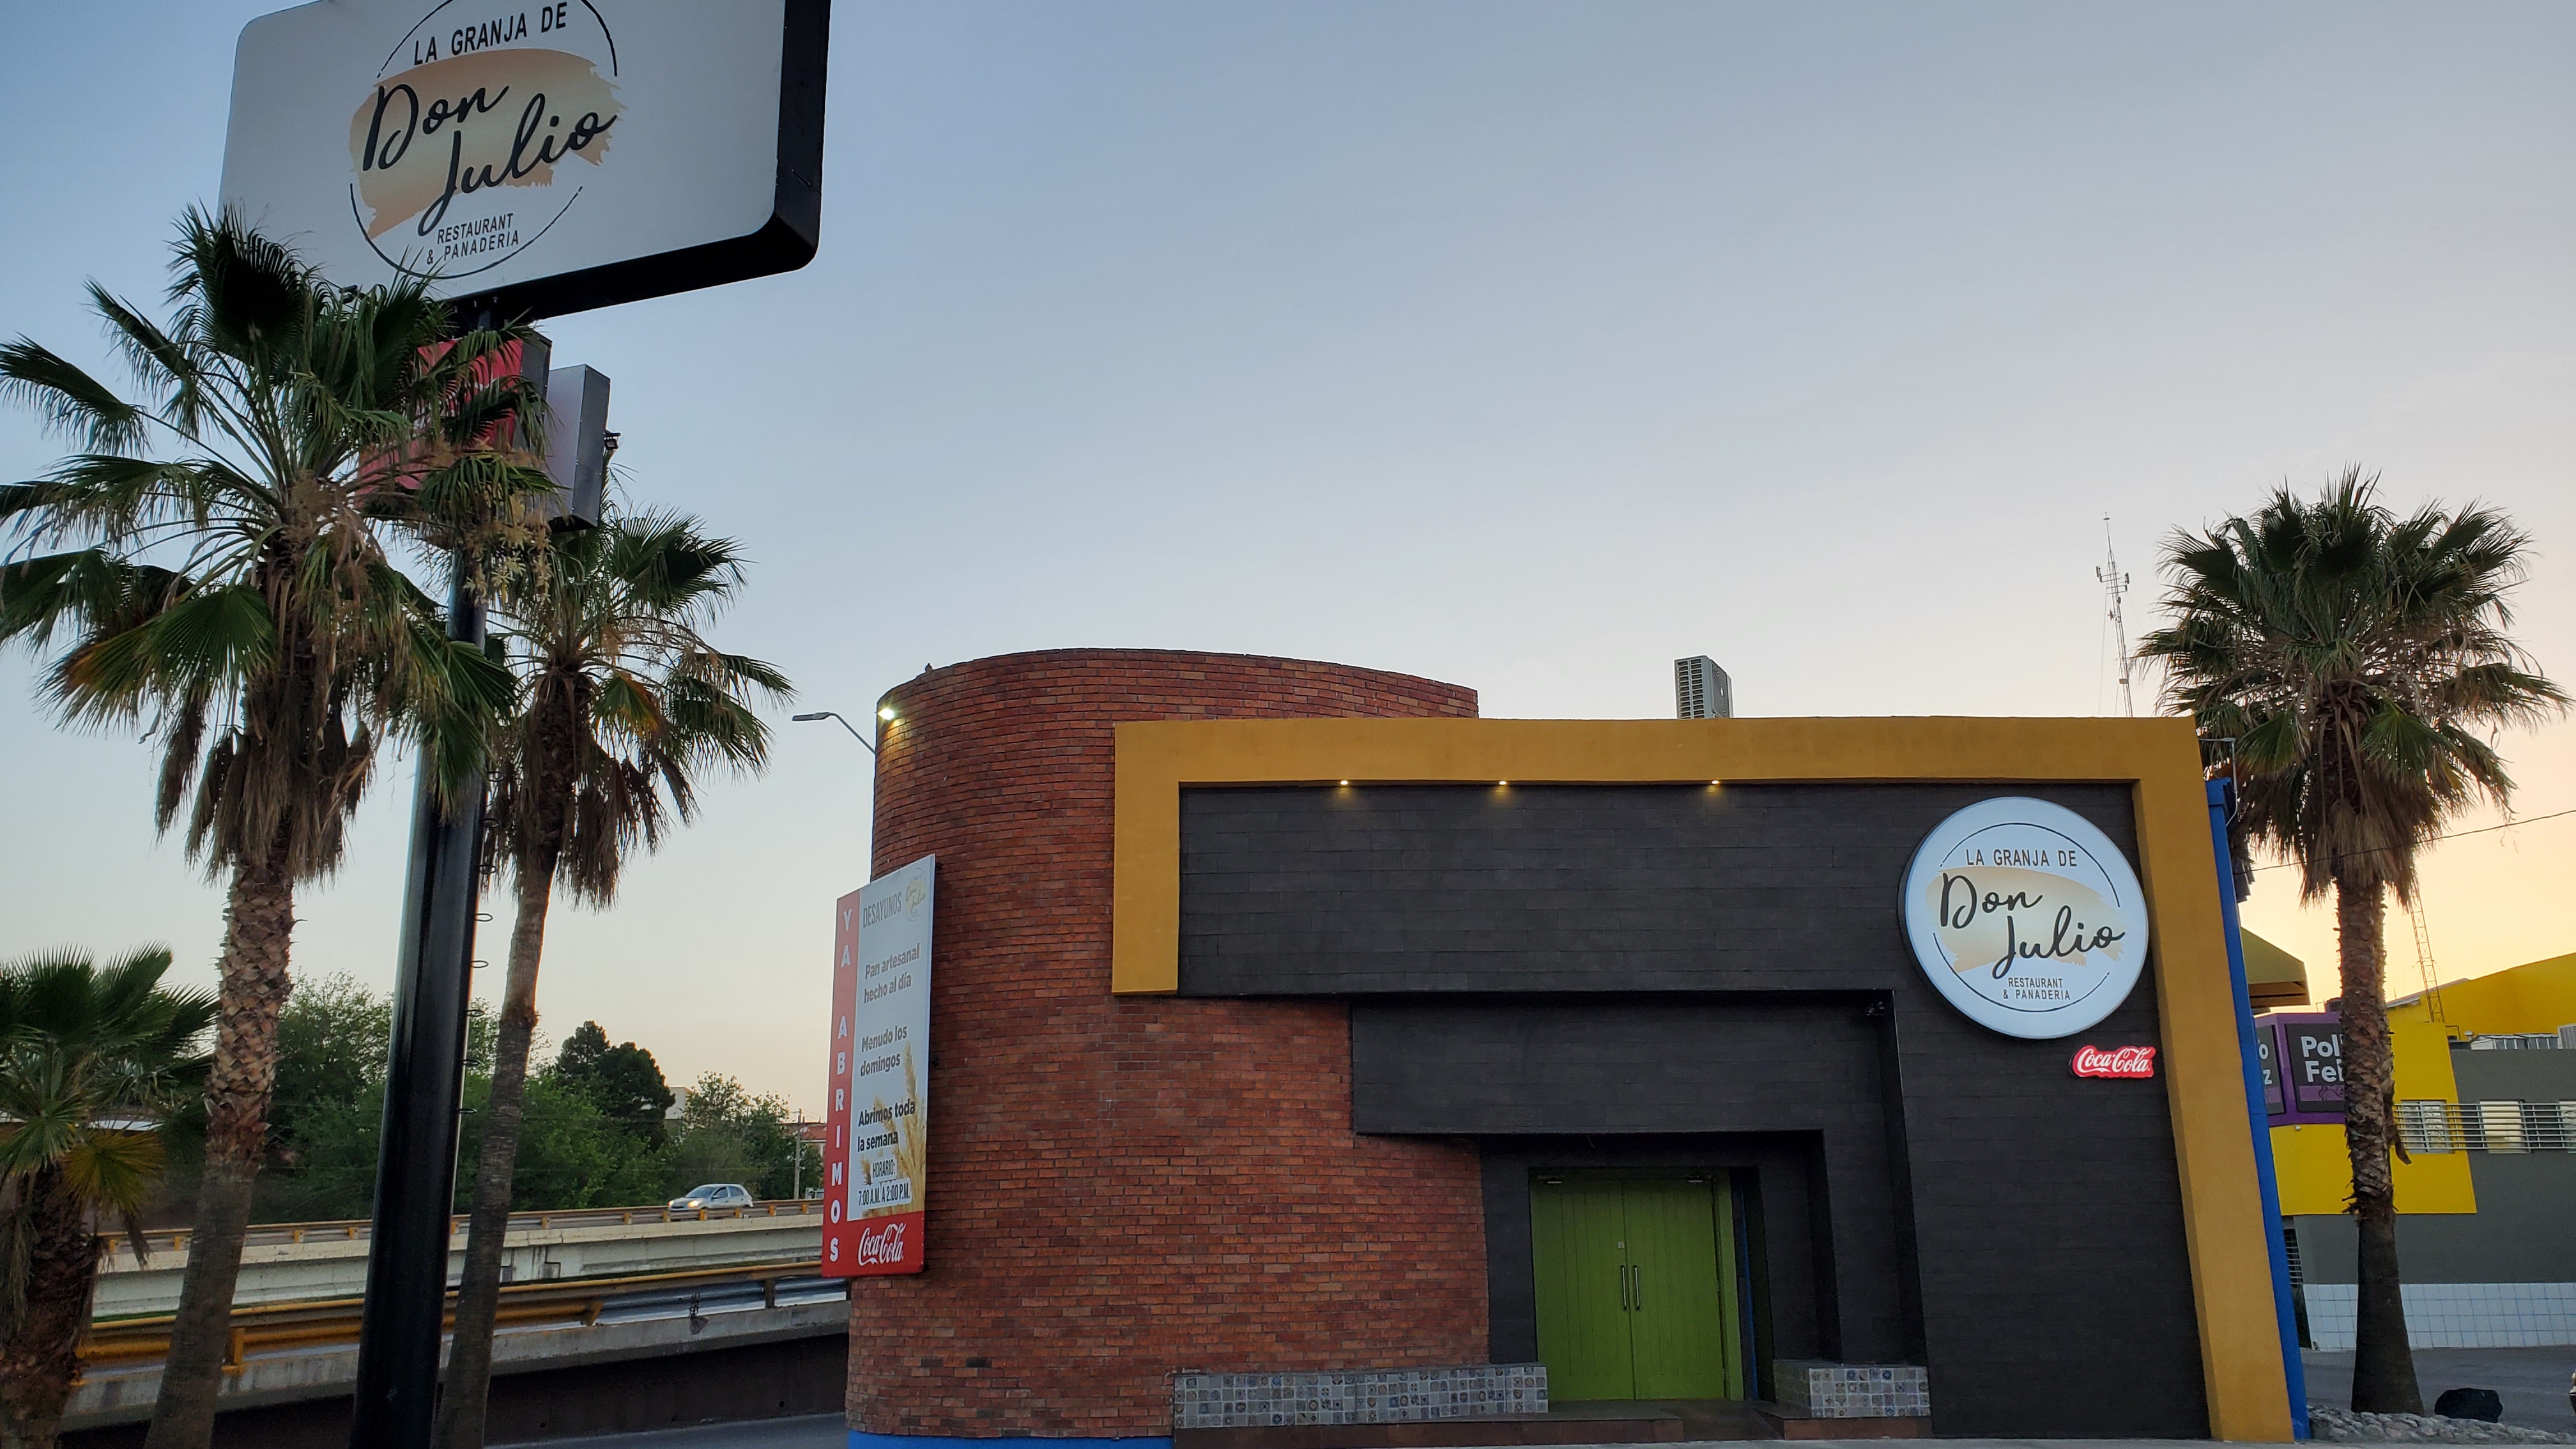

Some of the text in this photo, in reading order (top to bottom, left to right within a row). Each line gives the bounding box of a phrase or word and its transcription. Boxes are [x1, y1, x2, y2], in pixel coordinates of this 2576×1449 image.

[414, 2, 567, 65] LA GRANJA DE
[362, 84, 509, 171] Don
[417, 93, 617, 236] Julio
[437, 213, 514, 245] RESTAURANT
[427, 229, 519, 265] & PANADERIA
[1966, 848, 2078, 867] LA GRANJA DE
[862, 891, 902, 929] DESAYUNOS
[1940, 873, 2043, 929] Don
[1991, 905, 2126, 979] Julio
[865, 942, 920, 979] Pan artesanal
[864, 972, 912, 1004] hecho al día
[2003, 989, 2071, 1000] & PANADERIA
[2008, 977, 2063, 988] RESTAURANT
[861, 1025, 907, 1052] Menudo los
[2300, 1034, 2343, 1057] Pol
[860, 1052, 901, 1077] domingos
[2076, 1048, 2151, 1074] Coca-Cola
[858, 1098, 916, 1127] Abrimos toda
[857, 1131, 898, 1152] la semana
[872, 1158, 896, 1179] HORARIO:
[858, 1182, 910, 1206] 7:00 A.M. A 2:00 P.M.
[858, 1222, 907, 1266] Coca-Cola
